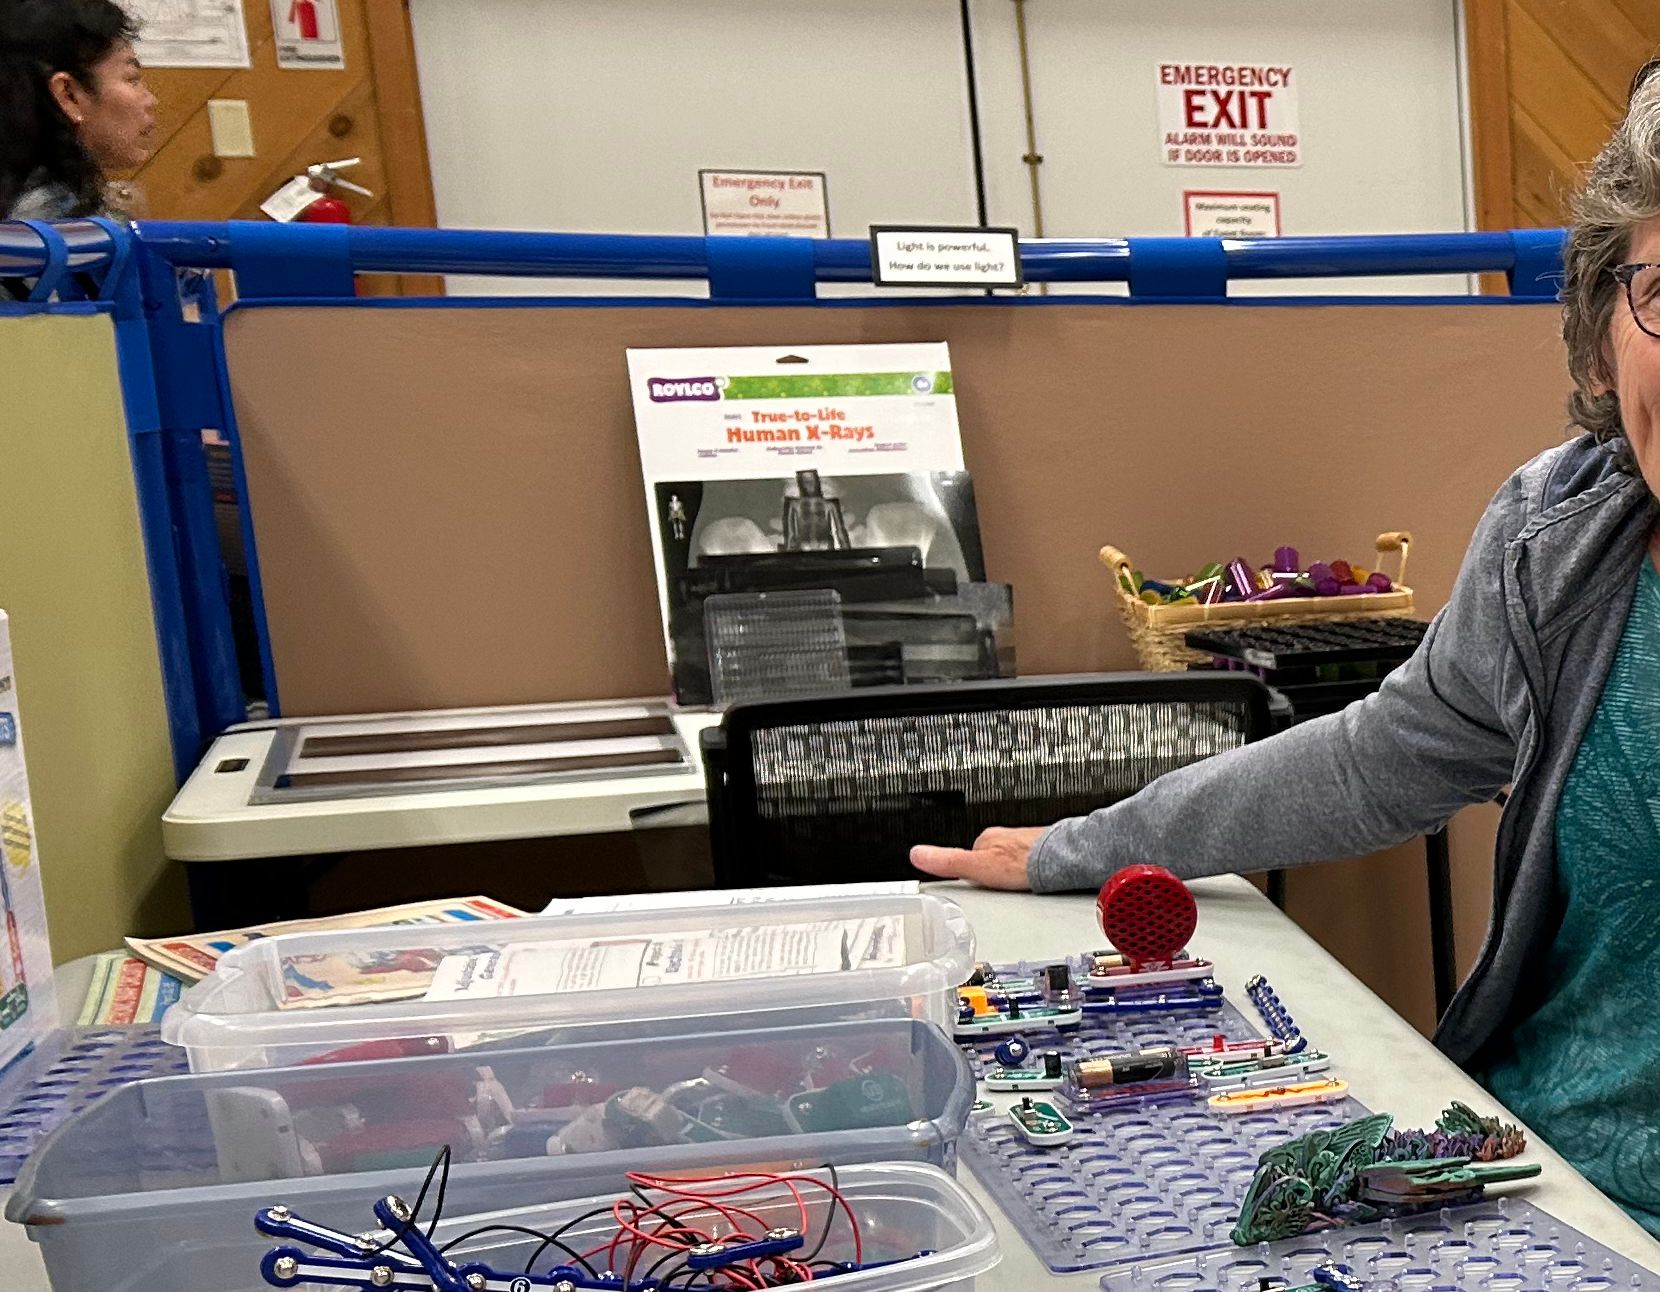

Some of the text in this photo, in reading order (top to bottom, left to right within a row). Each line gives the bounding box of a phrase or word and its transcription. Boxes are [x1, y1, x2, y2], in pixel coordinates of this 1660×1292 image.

[1160, 65, 1292, 87] EMERGENCY
[1184, 90, 1273, 129] EXIT
[1165, 132, 1297, 147] ALARM WILL SOUND
[1168, 148, 1297, 163] IF DOOR IS OPENED
[713, 176, 813, 190] Emergency Exit
[749, 193, 780, 209] Only
[897, 241, 991, 253] Light is powerful.
[889, 261, 1005, 273] How do we use light?
[651, 381, 715, 398] ROYLCO
[751, 407, 847, 424] True-to-Life
[726, 423, 875, 443] Human X-Rays
